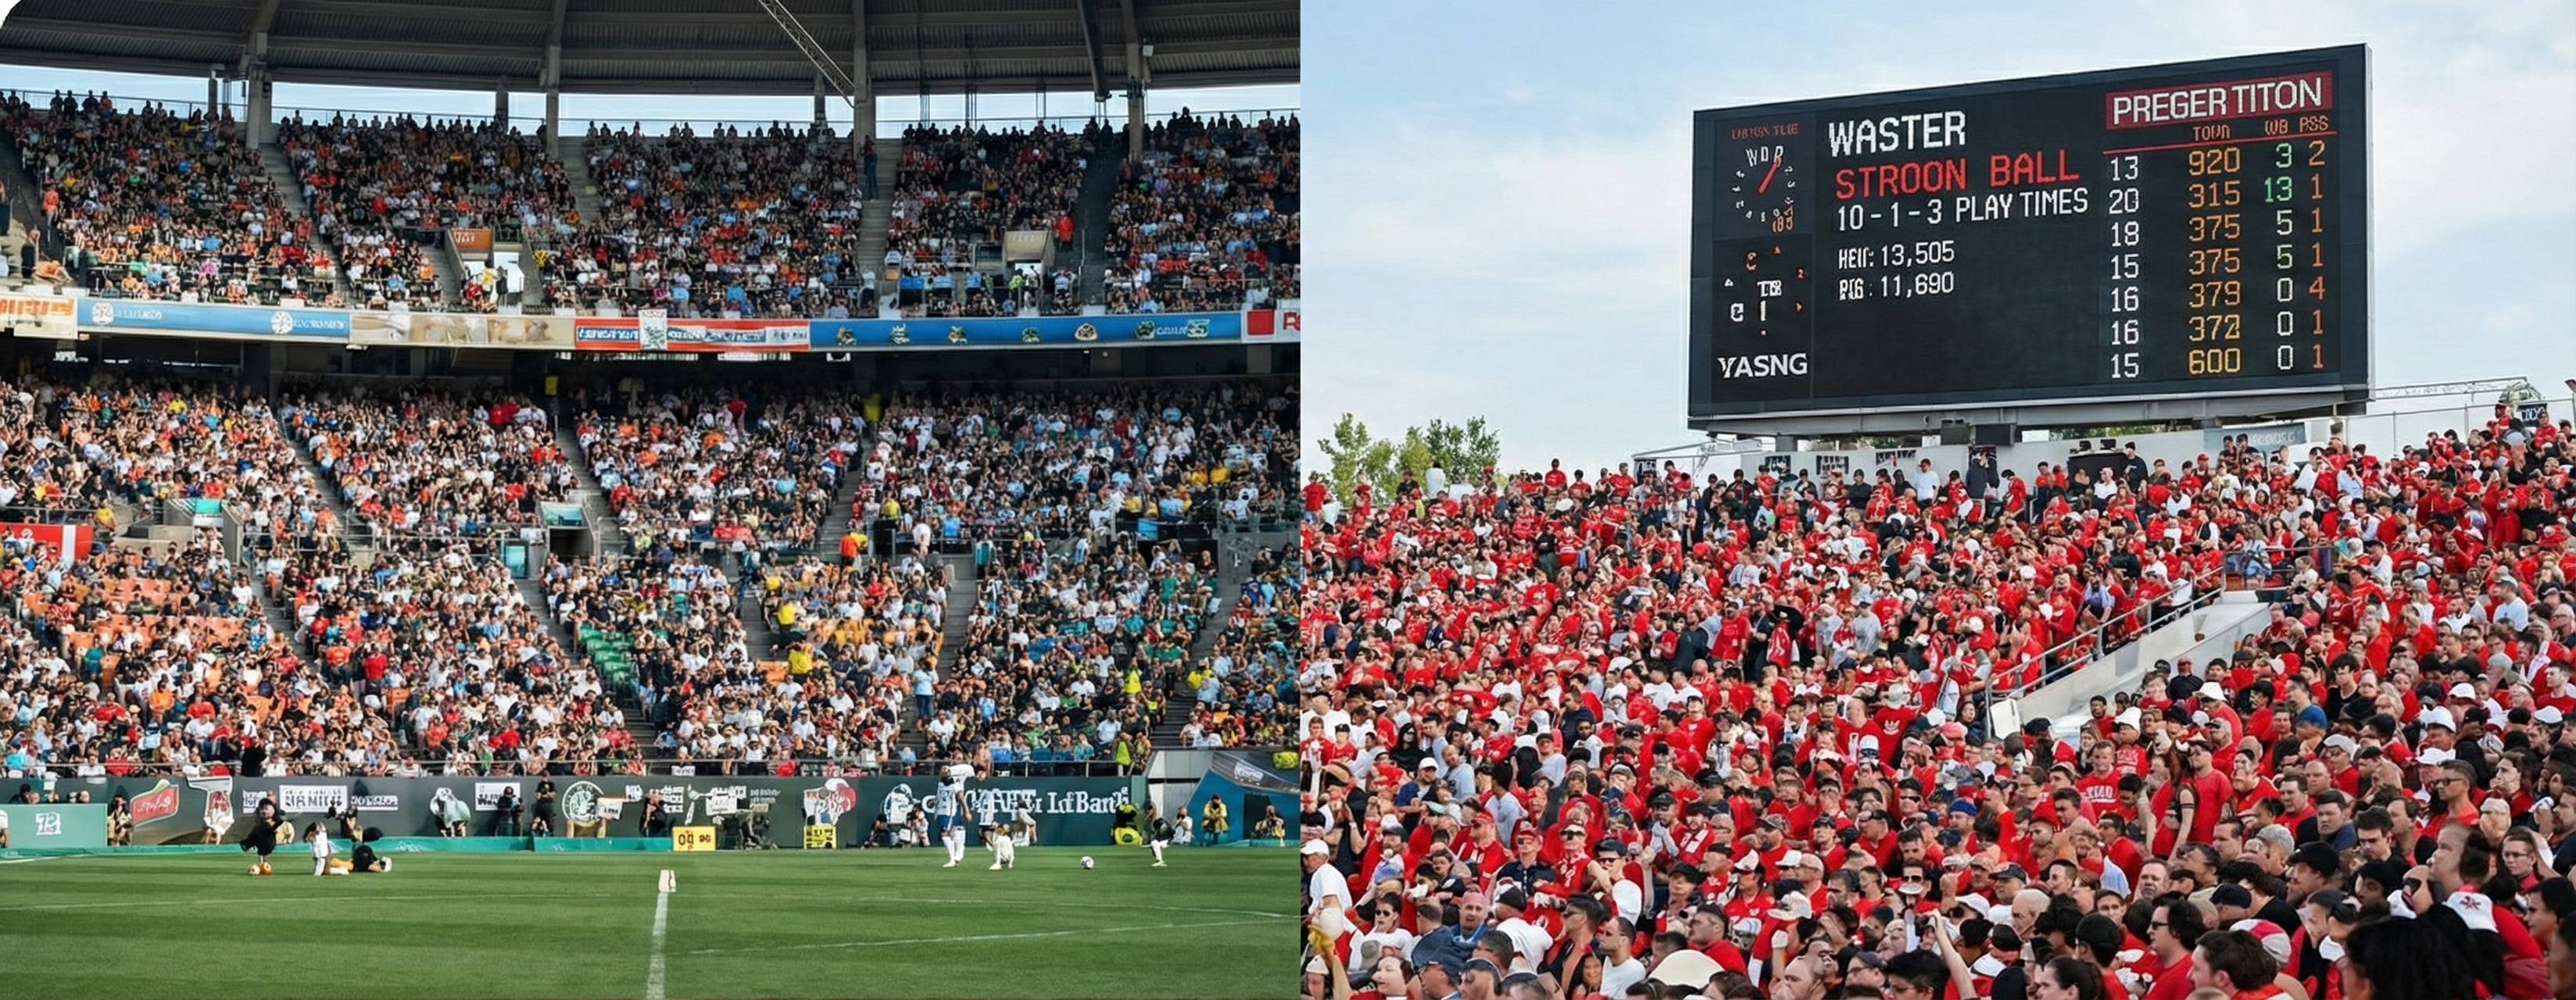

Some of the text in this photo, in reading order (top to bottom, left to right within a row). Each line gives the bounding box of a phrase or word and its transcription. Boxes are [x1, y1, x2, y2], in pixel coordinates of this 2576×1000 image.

[2113, 77, 2322, 125] PREGER TITON
[1829, 110, 1966, 157] WASTER
[1836, 149, 2080, 199] STROON BALL
[2110, 140, 2326, 181] 13 920 3 2
[1955, 193, 2013, 223] PLAY
[2020, 187, 2089, 217] TIMES
[2109, 173, 2324, 215] 20 315 13 1
[2111, 207, 2324, 247] 18 375 5 1
[1881, 240, 1955, 267] 13,505
[2111, 241, 2324, 280] 15 375 5 1
[1880, 271, 1955, 298] 11,690
[2111, 275, 2326, 312] 16 379 0 4
[2111, 319, 2140, 345] 16
[2277, 311, 2293, 336] 0
[2313, 309, 2324, 334] 1
[2111, 344, 2324, 378] 15 600 0 1
